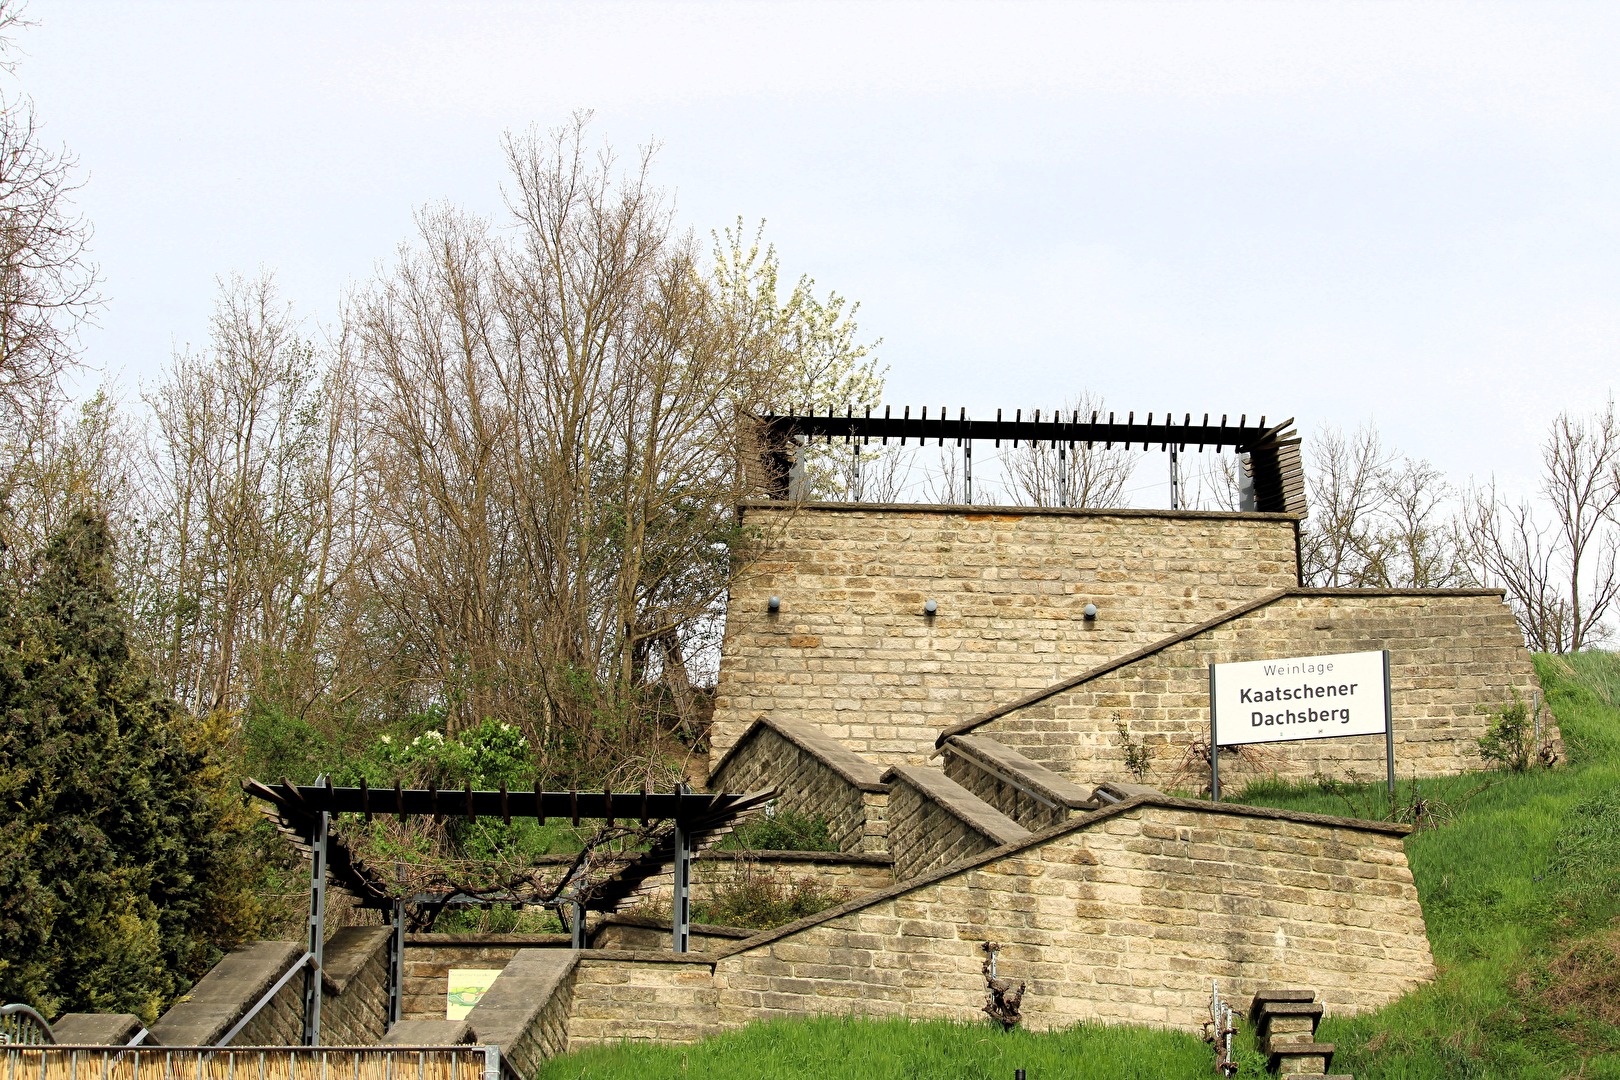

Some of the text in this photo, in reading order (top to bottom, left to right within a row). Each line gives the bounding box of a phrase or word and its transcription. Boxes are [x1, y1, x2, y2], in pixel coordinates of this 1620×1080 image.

[1264, 663, 1334, 676] Weinlage
[1240, 683, 1358, 704] Kaatschener
[1251, 708, 1350, 727] Dachsberg
